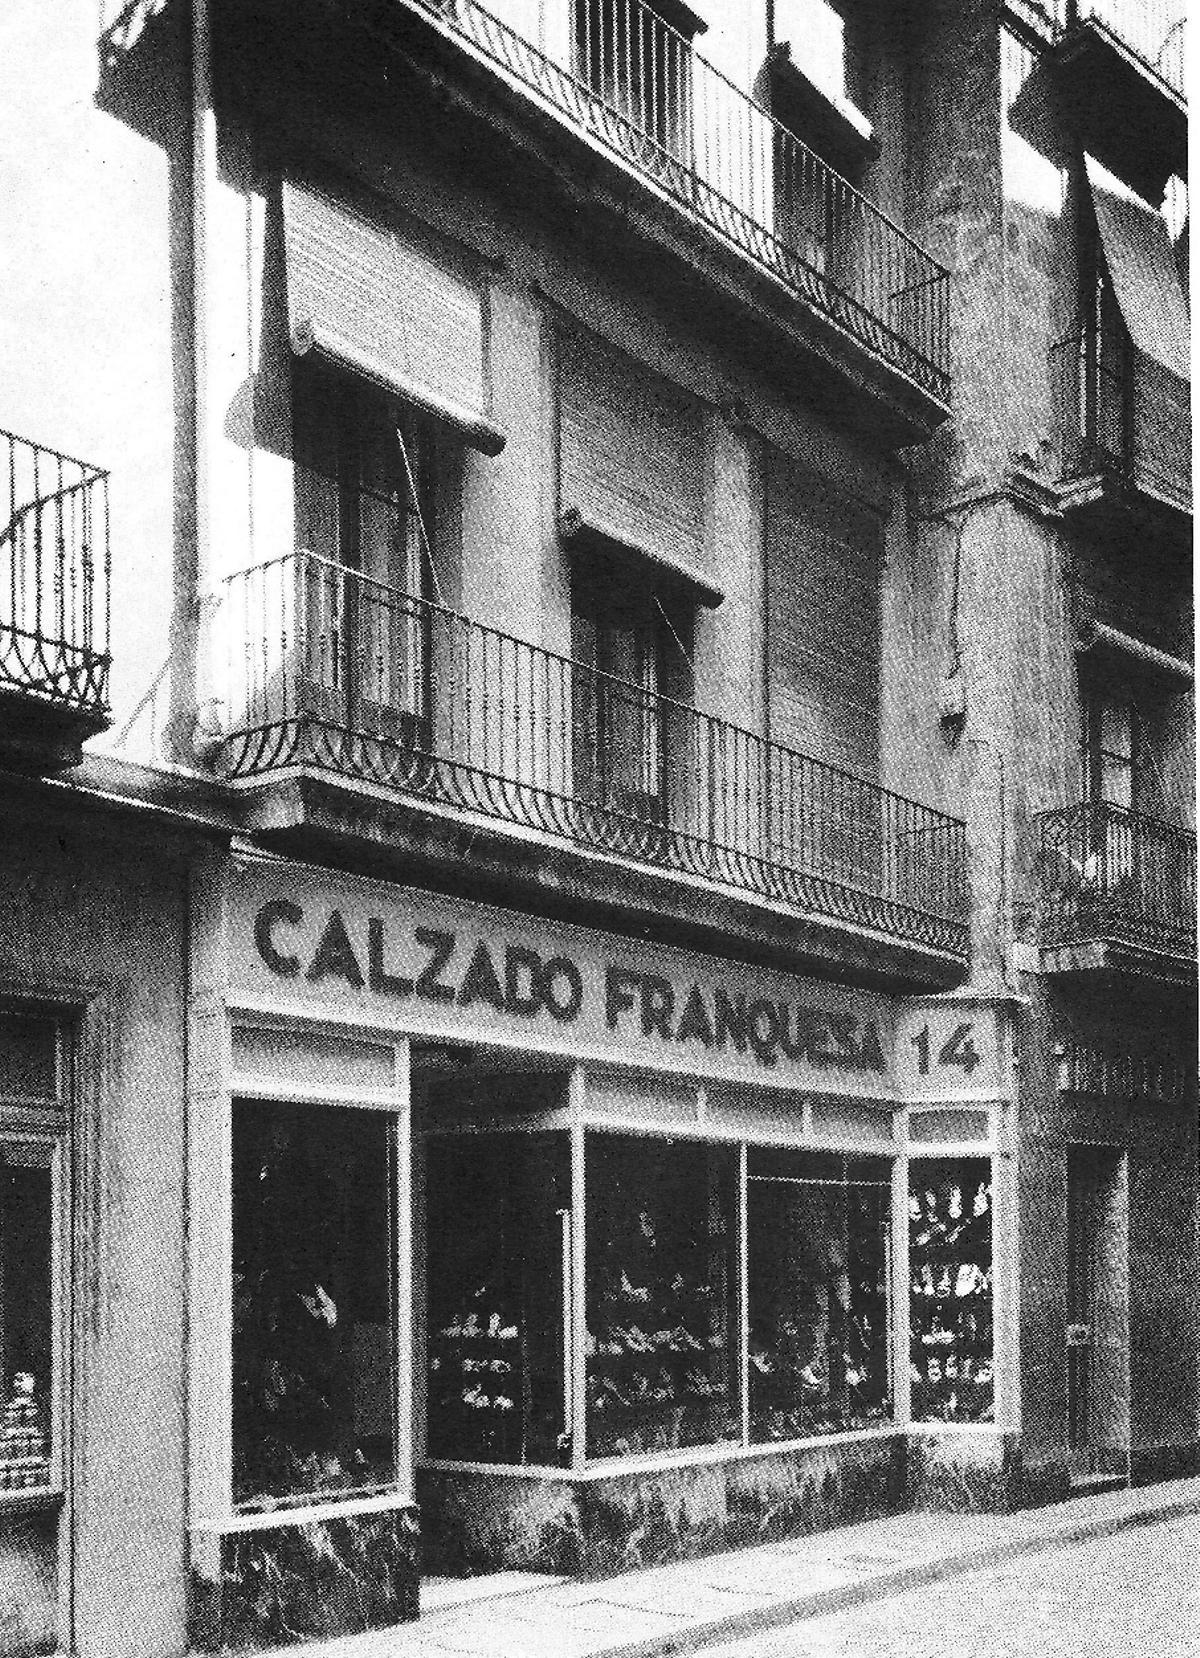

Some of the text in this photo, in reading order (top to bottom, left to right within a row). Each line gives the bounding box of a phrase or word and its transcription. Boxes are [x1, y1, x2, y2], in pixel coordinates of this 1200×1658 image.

[253, 899, 888, 1074] CALZADO FRANQUESA
[911, 1022, 981, 1075] 14
